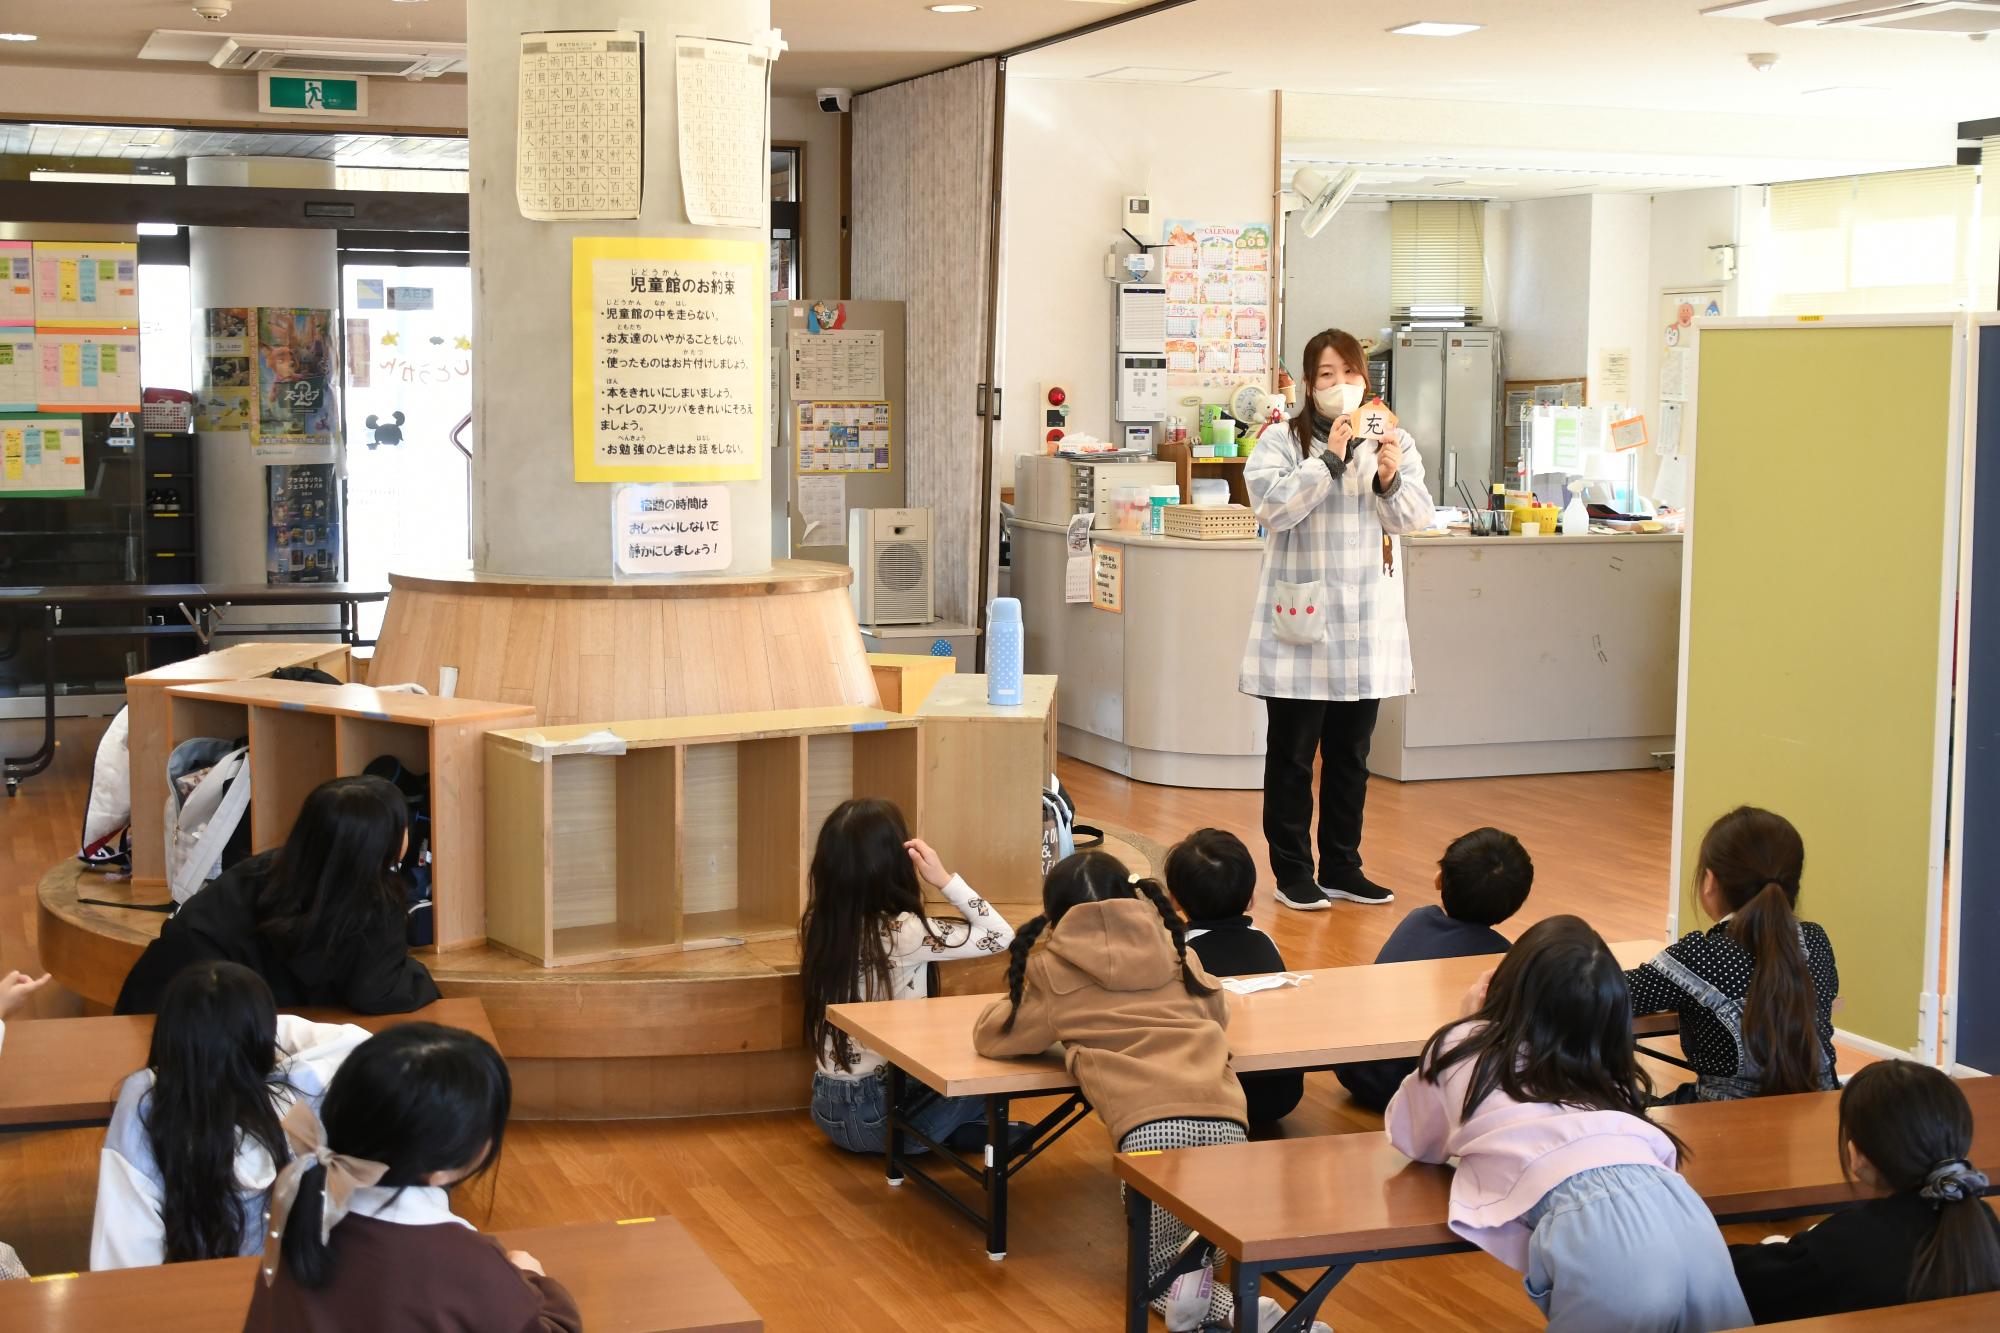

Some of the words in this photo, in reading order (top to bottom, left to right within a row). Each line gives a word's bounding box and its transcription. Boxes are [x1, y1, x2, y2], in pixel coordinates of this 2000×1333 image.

[1204, 227, 1240, 235] CALENDAR
[630, 276, 736, 295] 児童館のお約束
[600, 419, 644, 431] ましょう。
[1363, 413, 1384, 435] 充
[640, 497, 708, 512] 宿題の時間は
[629, 520, 719, 534] おしゃべりしないで
